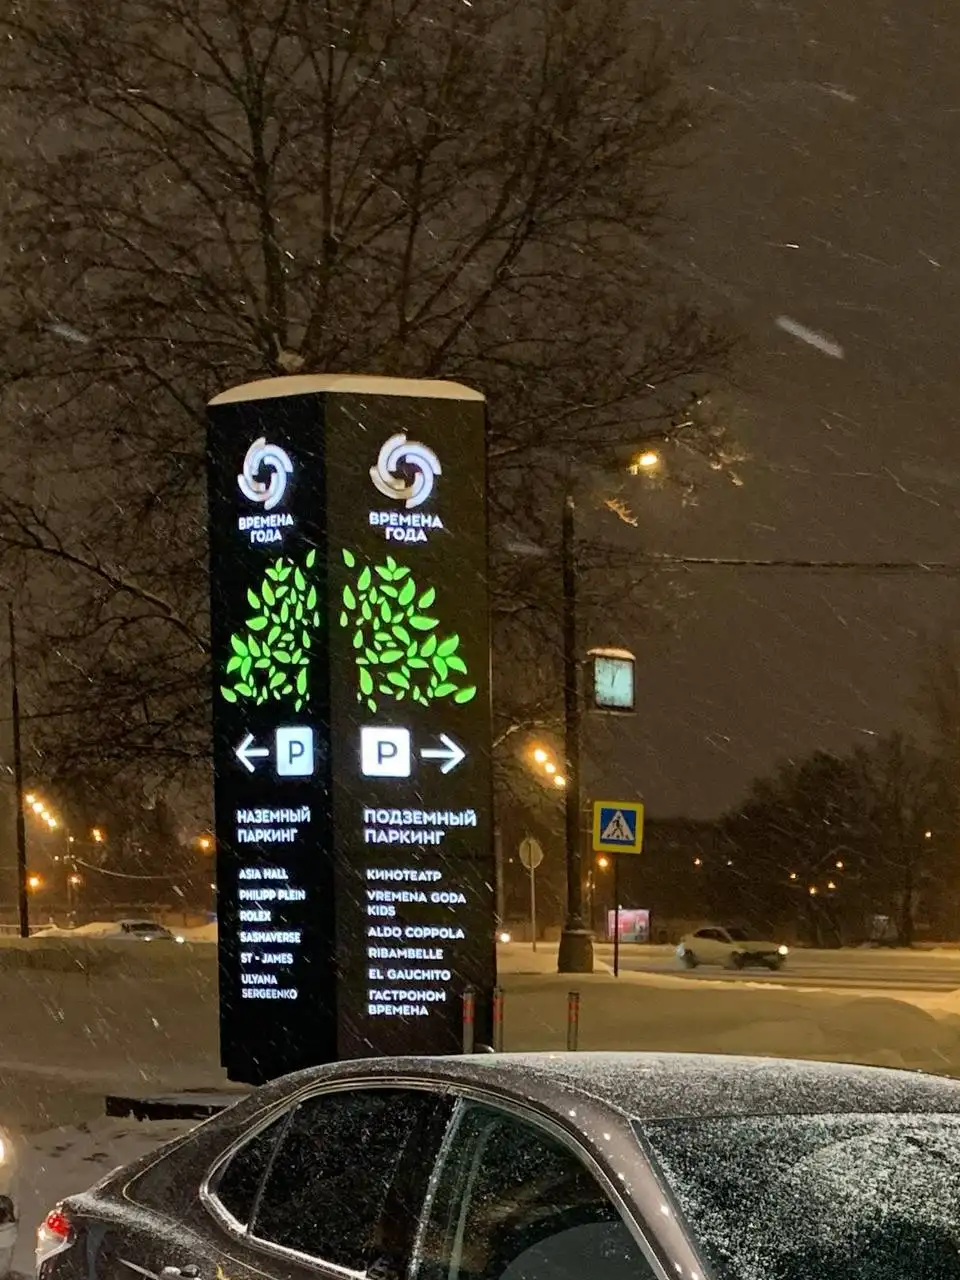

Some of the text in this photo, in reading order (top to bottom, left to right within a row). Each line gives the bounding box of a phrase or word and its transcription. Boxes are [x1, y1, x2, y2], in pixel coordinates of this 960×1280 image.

[238, 514, 294, 530] ВРЕМЕНА
[368, 511, 443, 528] ВРЕМЕНА
[250, 529, 282, 543] ГОДА
[385, 526, 428, 543] ГОДА
[289, 740, 305, 764] P
[378, 740, 397, 764] P
[237, 806, 311, 823] НАЗЕМНЫЙ
[364, 809, 477, 826] ПОДЗЕМНЫЙ
[237, 828, 298, 843] ПАРКИНГ
[364, 829, 445, 845] ПАРКИНГ
[239, 868, 289, 880] ASIA HALL
[366, 869, 442, 882] КИНОТЕАТР
[239, 889, 306, 900] PHILIPP PLEIN
[367, 890, 467, 904] VREMENA GODA
[240, 910, 271, 922] ROLEX
[367, 905, 396, 917] KIDS
[240, 931, 301, 944] SASHAVERSE
[368, 926, 465, 940] ALDO COPPOLA
[241, 953, 252, 964] ST
[261, 953, 294, 964] JAMES
[368, 947, 443, 960] RIBAMBELLE
[241, 973, 278, 985] ULYANA
[368, 968, 451, 981] EL GAUCHITO
[242, 988, 298, 1000] SERGEENKO
[368, 989, 446, 1002] ГАСТРОНОМ
[368, 1004, 429, 1017] ВРЕМЕНА
